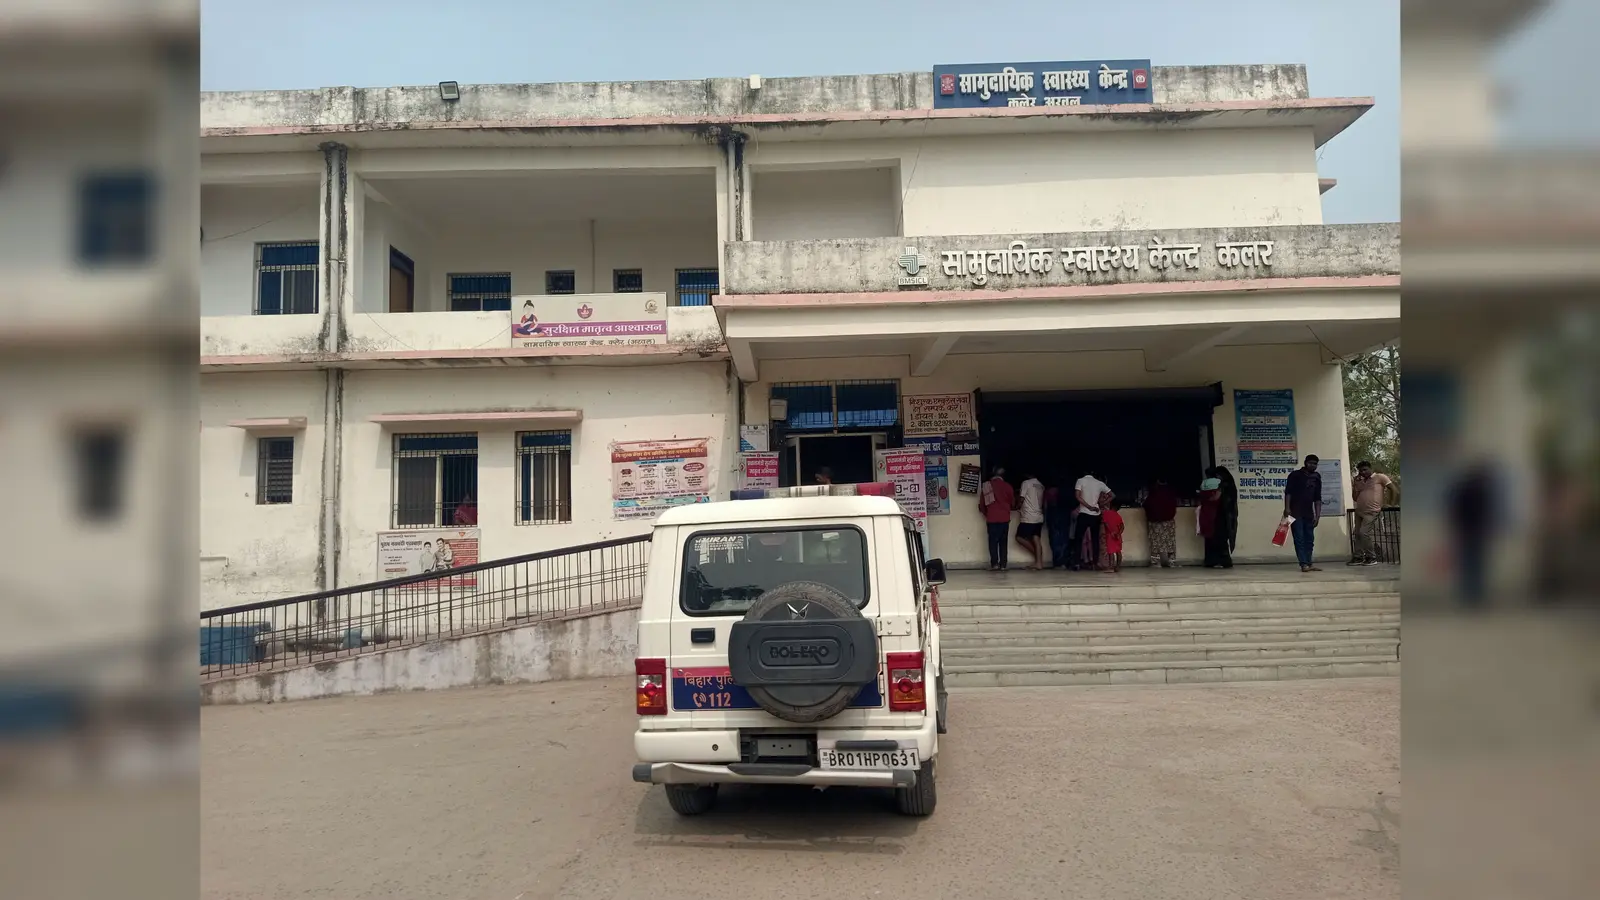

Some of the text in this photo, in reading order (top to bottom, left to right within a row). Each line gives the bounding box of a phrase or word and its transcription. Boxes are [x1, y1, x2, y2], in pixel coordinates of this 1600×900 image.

[958, 64, 1128, 100] सामुदायिक स्वास्थ्य केन्द्र
[942, 240, 1053, 286] सामुदायिक
[1062, 244, 1140, 273] स्वास्थ्य
[1148, 237, 1201, 270] केन्द्र
[542, 323, 662, 336] सुरक्षित मातृत्व आश्वासन
[770, 645, 830, 664] BOLERO
[684, 671, 733, 690] बिहार पुलि
[709, 692, 731, 707] 112
[829, 752, 917, 767] BR01HP0631
